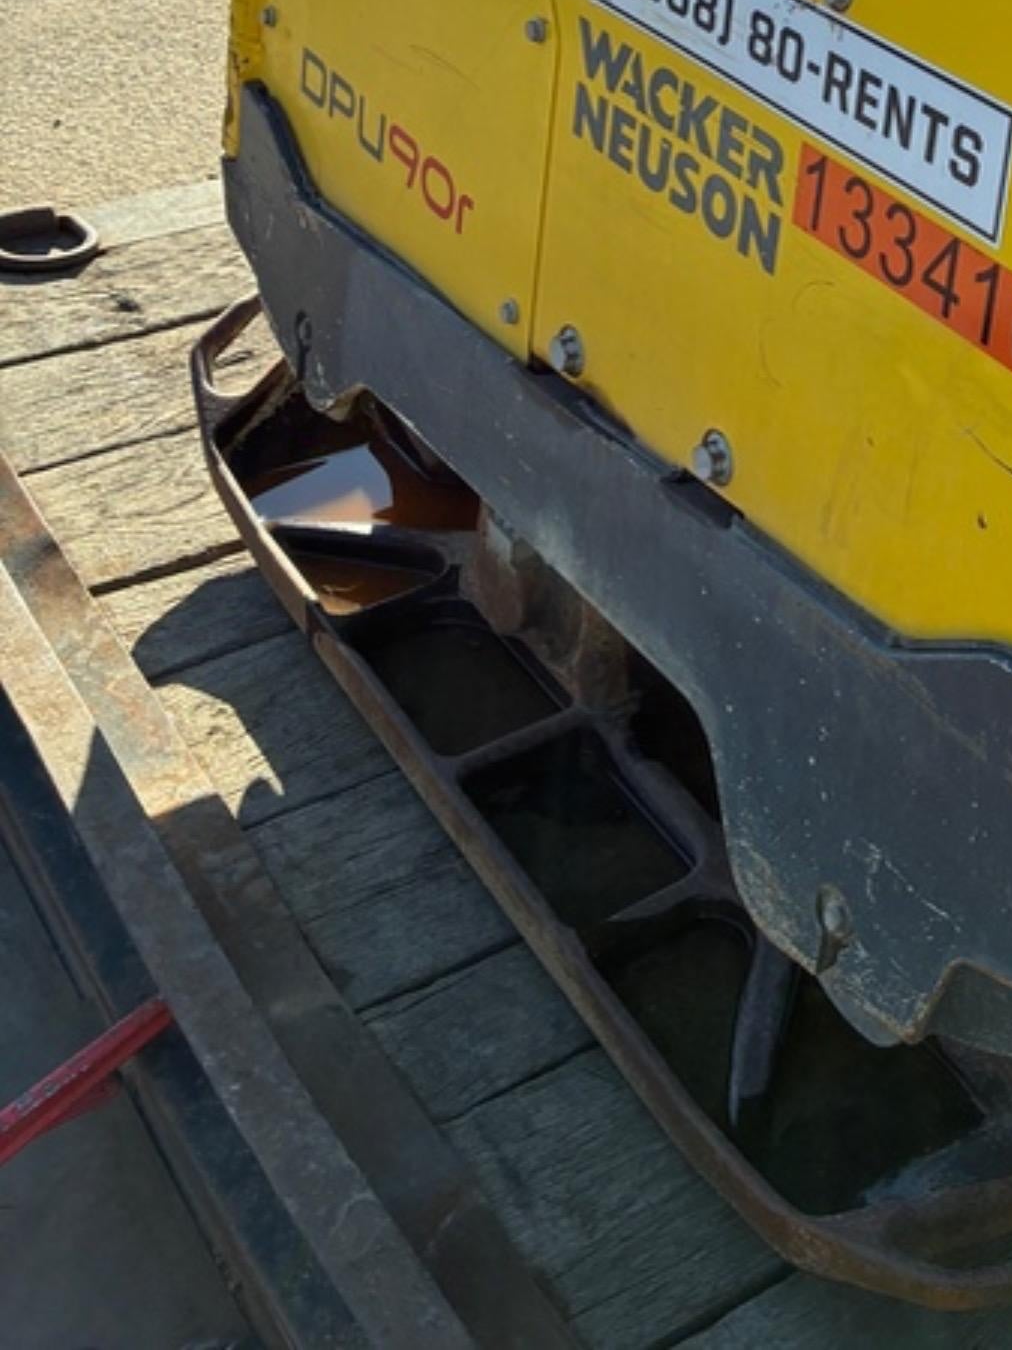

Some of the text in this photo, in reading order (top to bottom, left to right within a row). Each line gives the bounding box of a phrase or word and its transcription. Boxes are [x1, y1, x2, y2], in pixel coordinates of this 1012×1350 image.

[572, 81, 782, 277] NEUSON
[578, 16, 785, 207] WACKER
[748, 9, 985, 189] 80-RENTS
